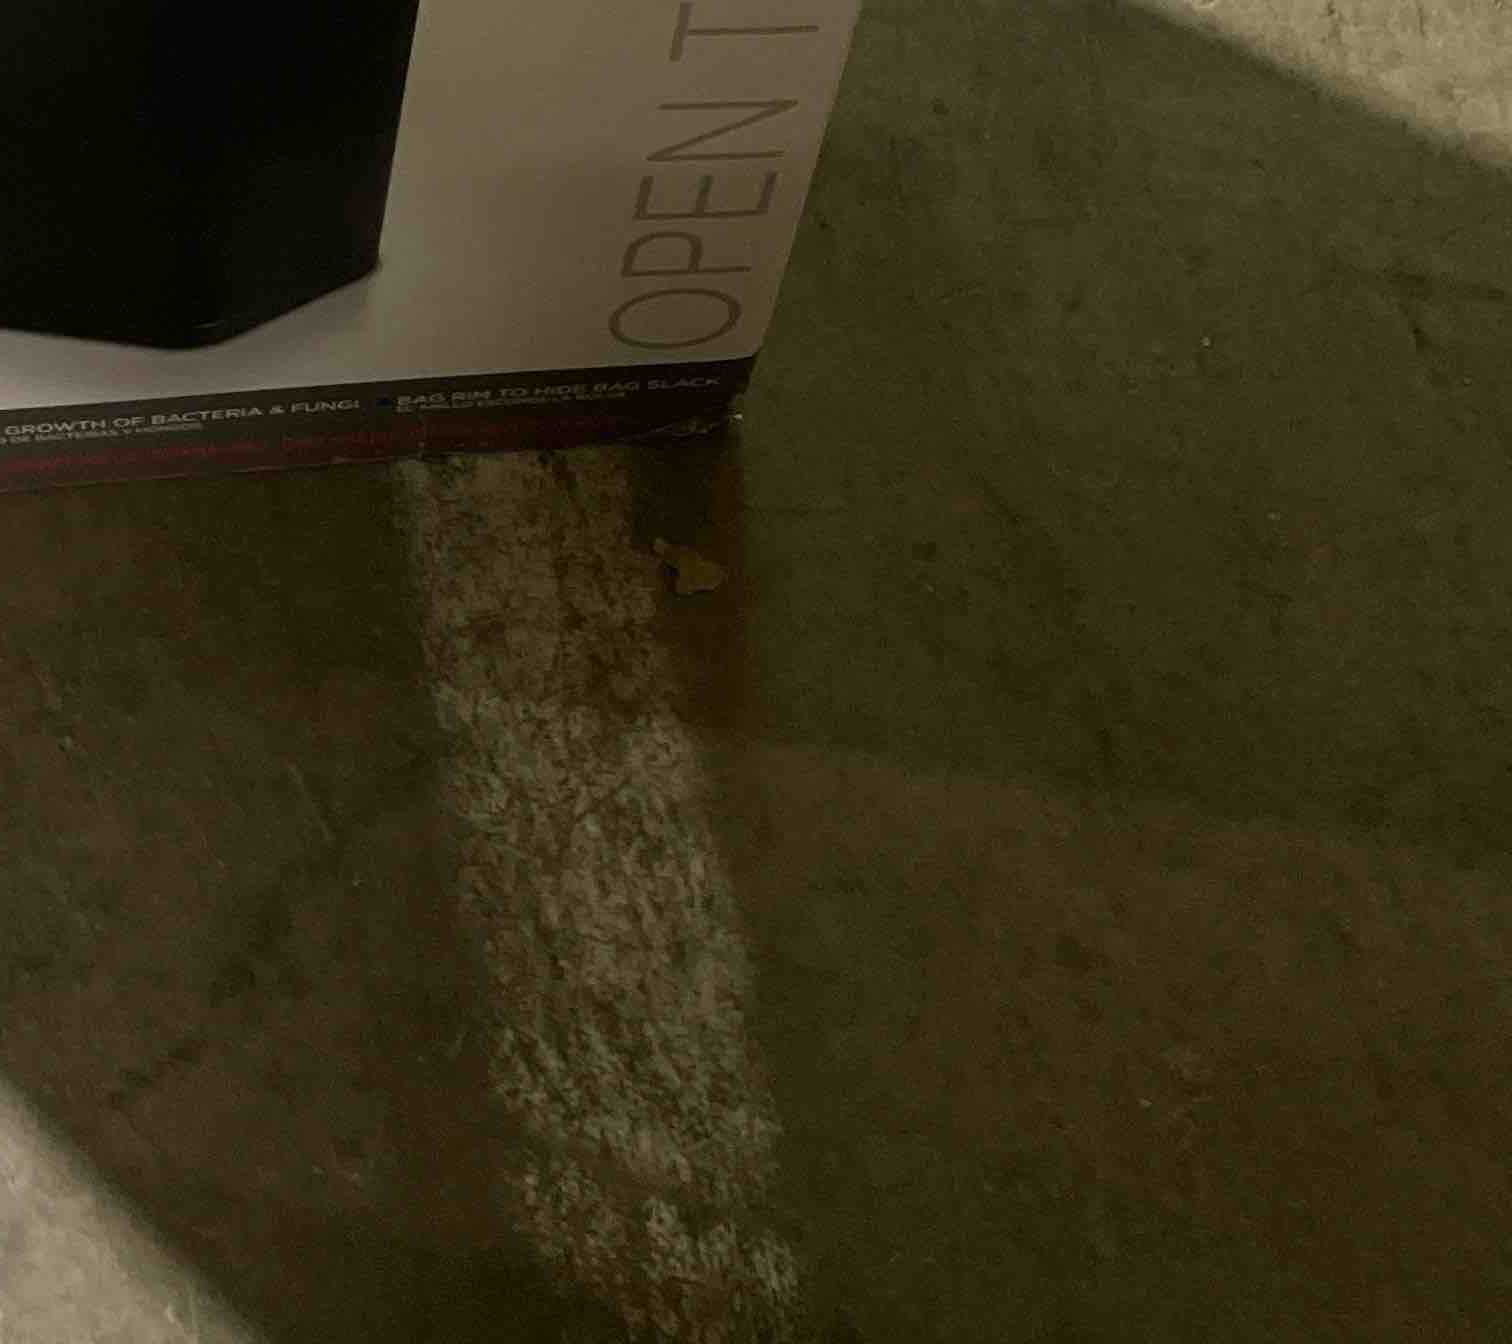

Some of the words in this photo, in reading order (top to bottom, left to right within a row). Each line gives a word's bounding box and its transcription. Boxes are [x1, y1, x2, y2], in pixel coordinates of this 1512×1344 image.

[609, 99, 798, 350] OPEN
[647, 376, 722, 391] SLACK
[4, 419, 106, 436] GROWTH
[112, 416, 146, 429] OF
[151, 406, 264, 426] BACTERIA
[269, 404, 285, 415] &
[291, 399, 361, 414] FUNGI
